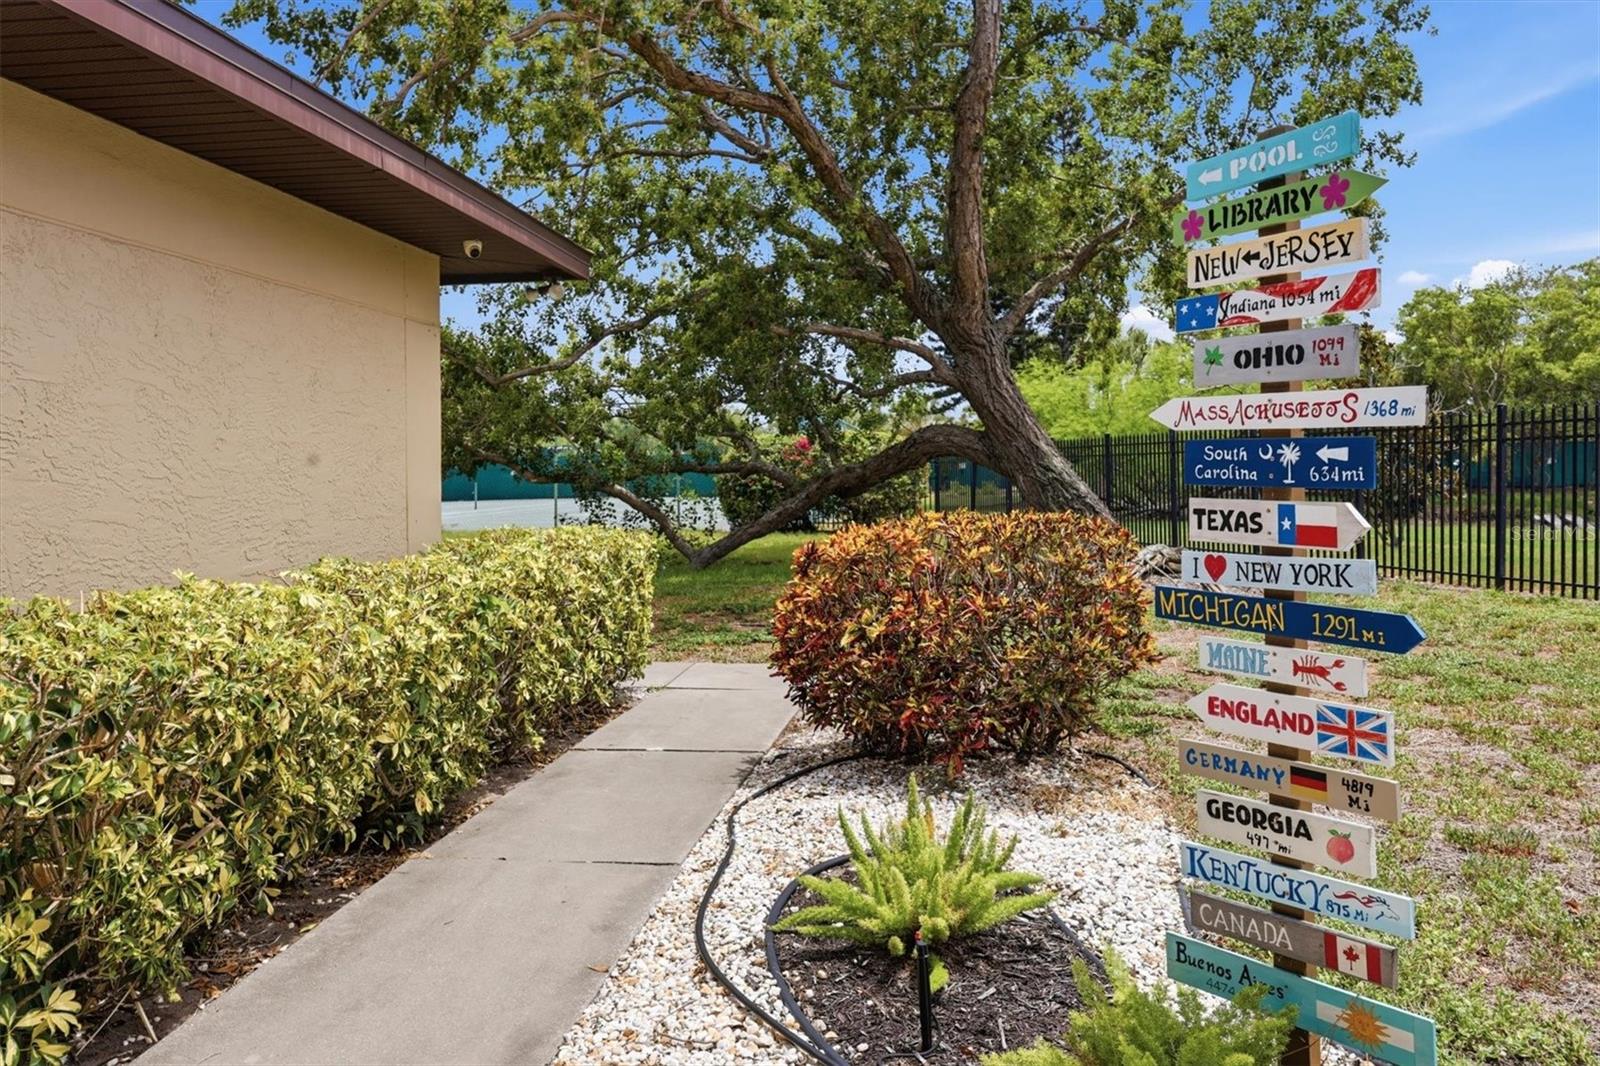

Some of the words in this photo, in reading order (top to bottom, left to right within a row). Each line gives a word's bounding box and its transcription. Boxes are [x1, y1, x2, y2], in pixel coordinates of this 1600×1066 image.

[1229, 139, 1303, 180] POOL
[1208, 184, 1319, 233] LIBRARY
[1194, 248, 1242, 283] NEW
[1259, 229, 1355, 271] JERSEY
[1218, 293, 1276, 323] Indiana
[1281, 290, 1315, 309] 1054
[1320, 285, 1341, 303] mi
[1233, 344, 1305, 370] OHIO
[1312, 336, 1345, 354] 1099
[1363, 399, 1398, 417] 1368
[1401, 405, 1417, 417] mi
[1194, 464, 1258, 481] Carolina
[1203, 446, 1248, 461] South
[1193, 508, 1264, 533] TEXAS
[1192, 557, 1199, 579] I
[1235, 561, 1282, 585] NEW
[1289, 563, 1353, 588] YORK
[1159, 590, 1285, 632] MICHIGAN
[1311, 612, 1359, 641] 1291
[1206, 642, 1271, 676] MAINE
[1207, 695, 1315, 736] ENGLAND
[1185, 748, 1286, 786] GERMANY
[1341, 777, 1374, 798] 4819
[1206, 798, 1314, 842] GEORGIA
[1246, 831, 1269, 849] 497
[1185, 846, 1329, 912] KENTUCKY
[1326, 900, 1351, 918] 875
[1199, 903, 1295, 952] CANADA
[1175, 941, 1232, 981] Buenos
